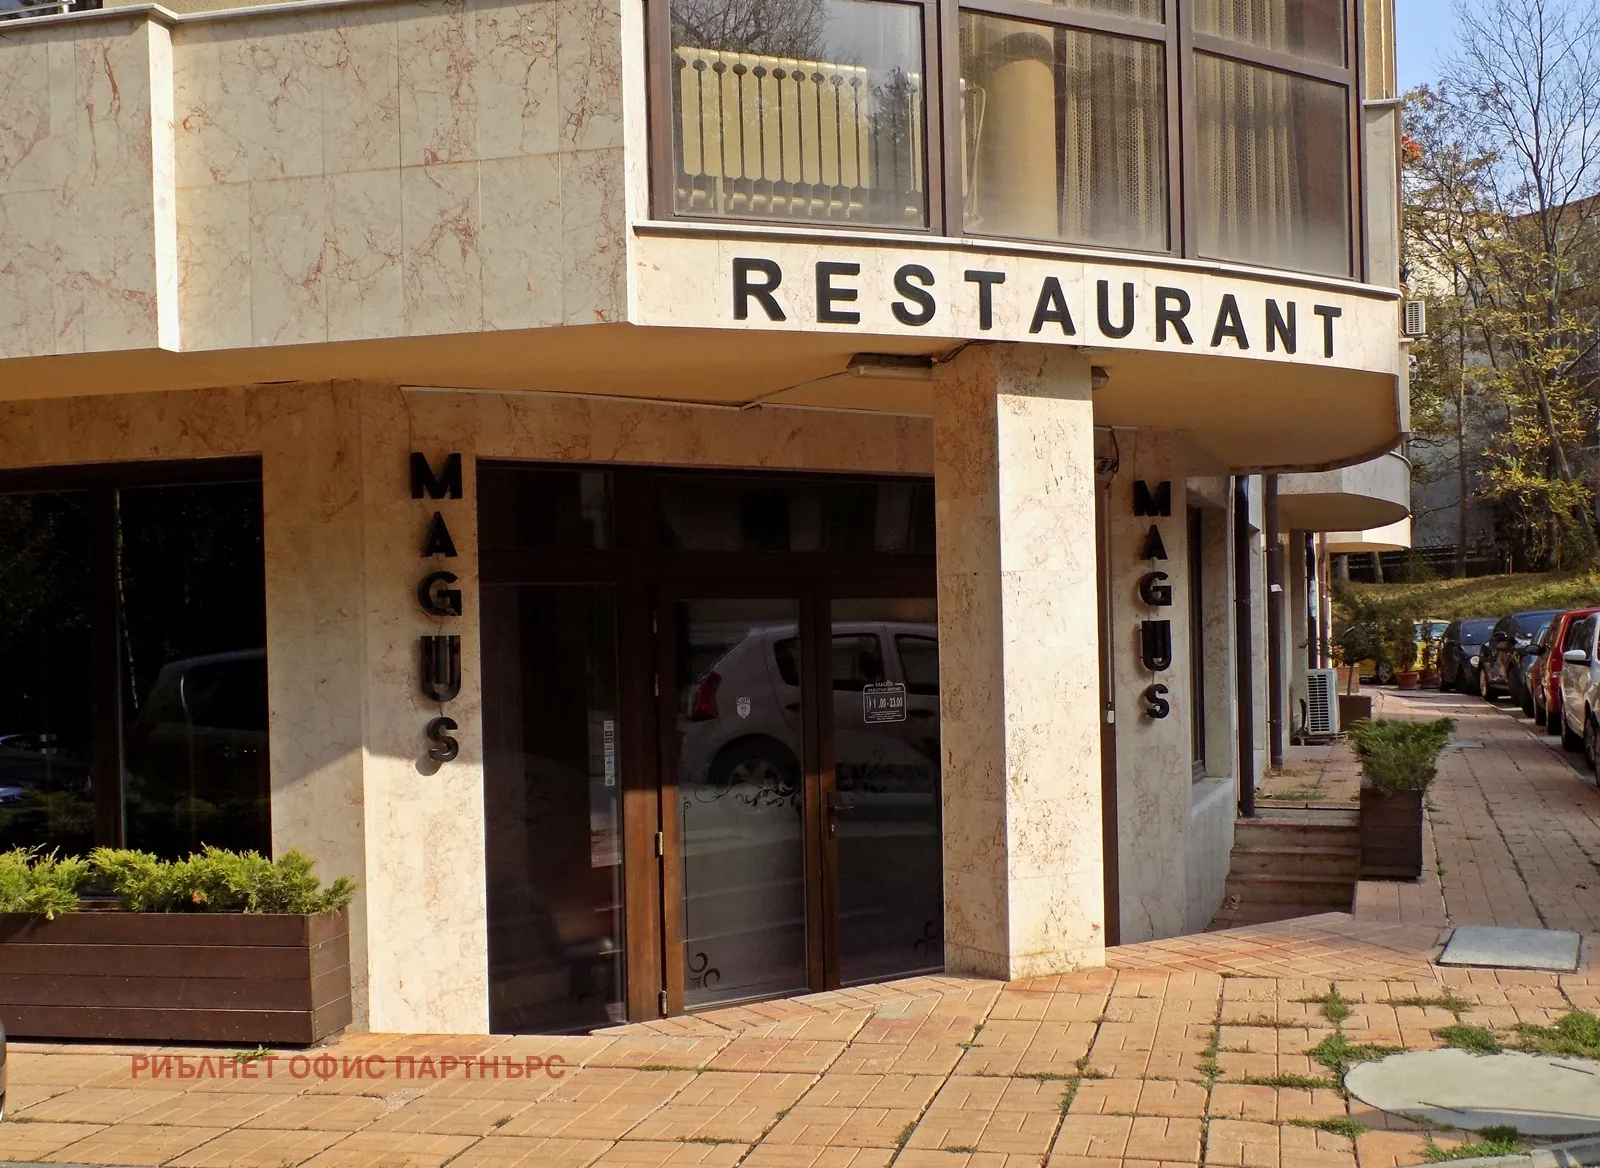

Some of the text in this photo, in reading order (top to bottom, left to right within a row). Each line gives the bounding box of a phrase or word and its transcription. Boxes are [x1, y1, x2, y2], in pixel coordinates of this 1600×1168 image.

[732, 257, 1342, 359] RESTAURANT
[410, 452, 463, 762] MAGUS
[1133, 479, 1172, 720] MAGUS
